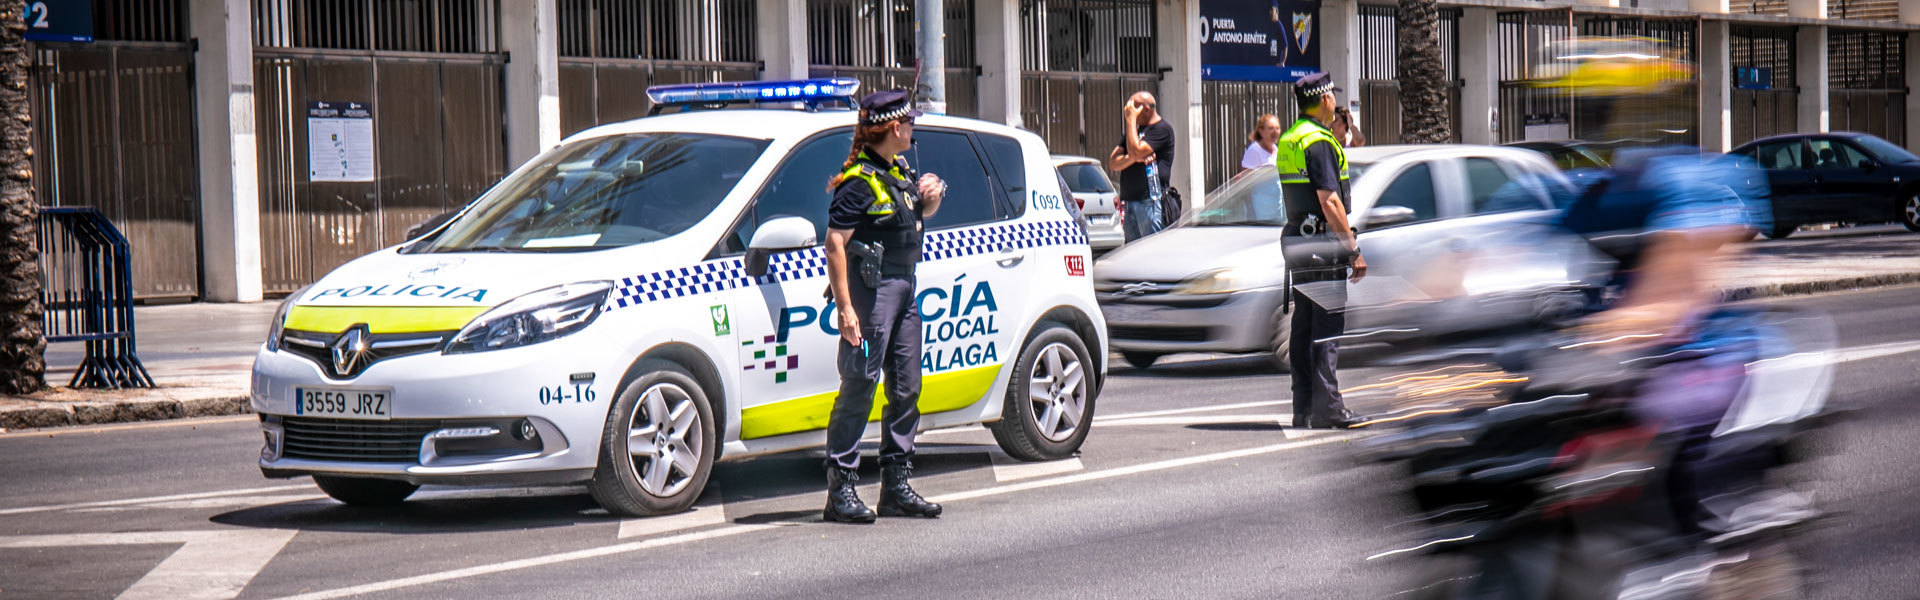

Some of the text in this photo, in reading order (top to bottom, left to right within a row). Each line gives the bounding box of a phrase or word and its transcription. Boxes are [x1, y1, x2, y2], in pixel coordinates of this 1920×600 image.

[1212, 17, 1236, 29] PUERTA
[1213, 30, 1267, 44] ANTONIO BENÍTEZ
[1039, 194, 1061, 210] 092
[1070, 256, 1083, 270] 112
[310, 284, 488, 302] POLICIA
[776, 273, 998, 343] POCÍA
[924, 314, 999, 344] LOCAL
[921, 341, 998, 373] ÁLAGA
[305, 391, 385, 415] 3559 JRZ
[539, 383, 596, 405] 04-16
